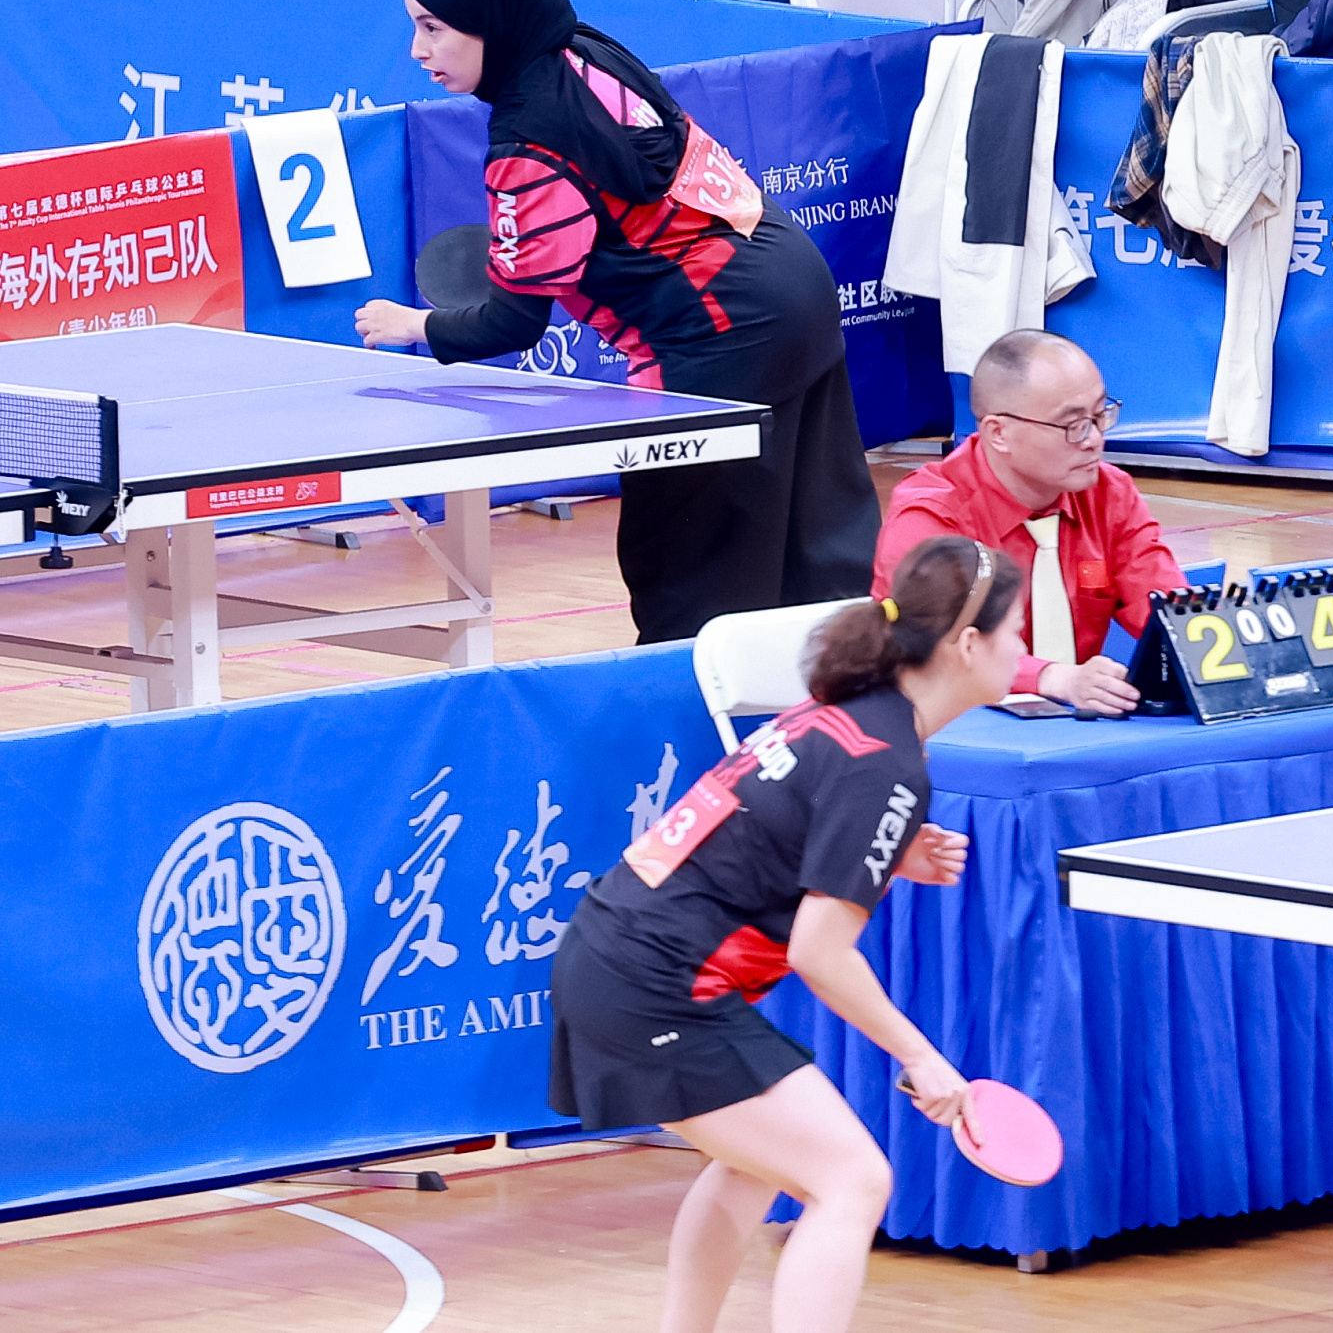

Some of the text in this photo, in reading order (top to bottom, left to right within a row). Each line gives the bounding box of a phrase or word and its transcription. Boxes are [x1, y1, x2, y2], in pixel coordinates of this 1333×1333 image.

[279, 153, 336, 243] 2
[761, 157, 850, 194] 南京分行
[0, 215, 219, 310] 海外存知己队
[491, 191, 519, 274] NEXY
[645, 438, 707, 464] NEXY
[60, 503, 91, 517] NEXY
[1185, 614, 1249, 681] 2
[1236, 608, 1265, 644] 0
[1265, 603, 1297, 638] 0
[863, 782, 919, 886] NEXY
[360, 1007, 448, 1051] THE
